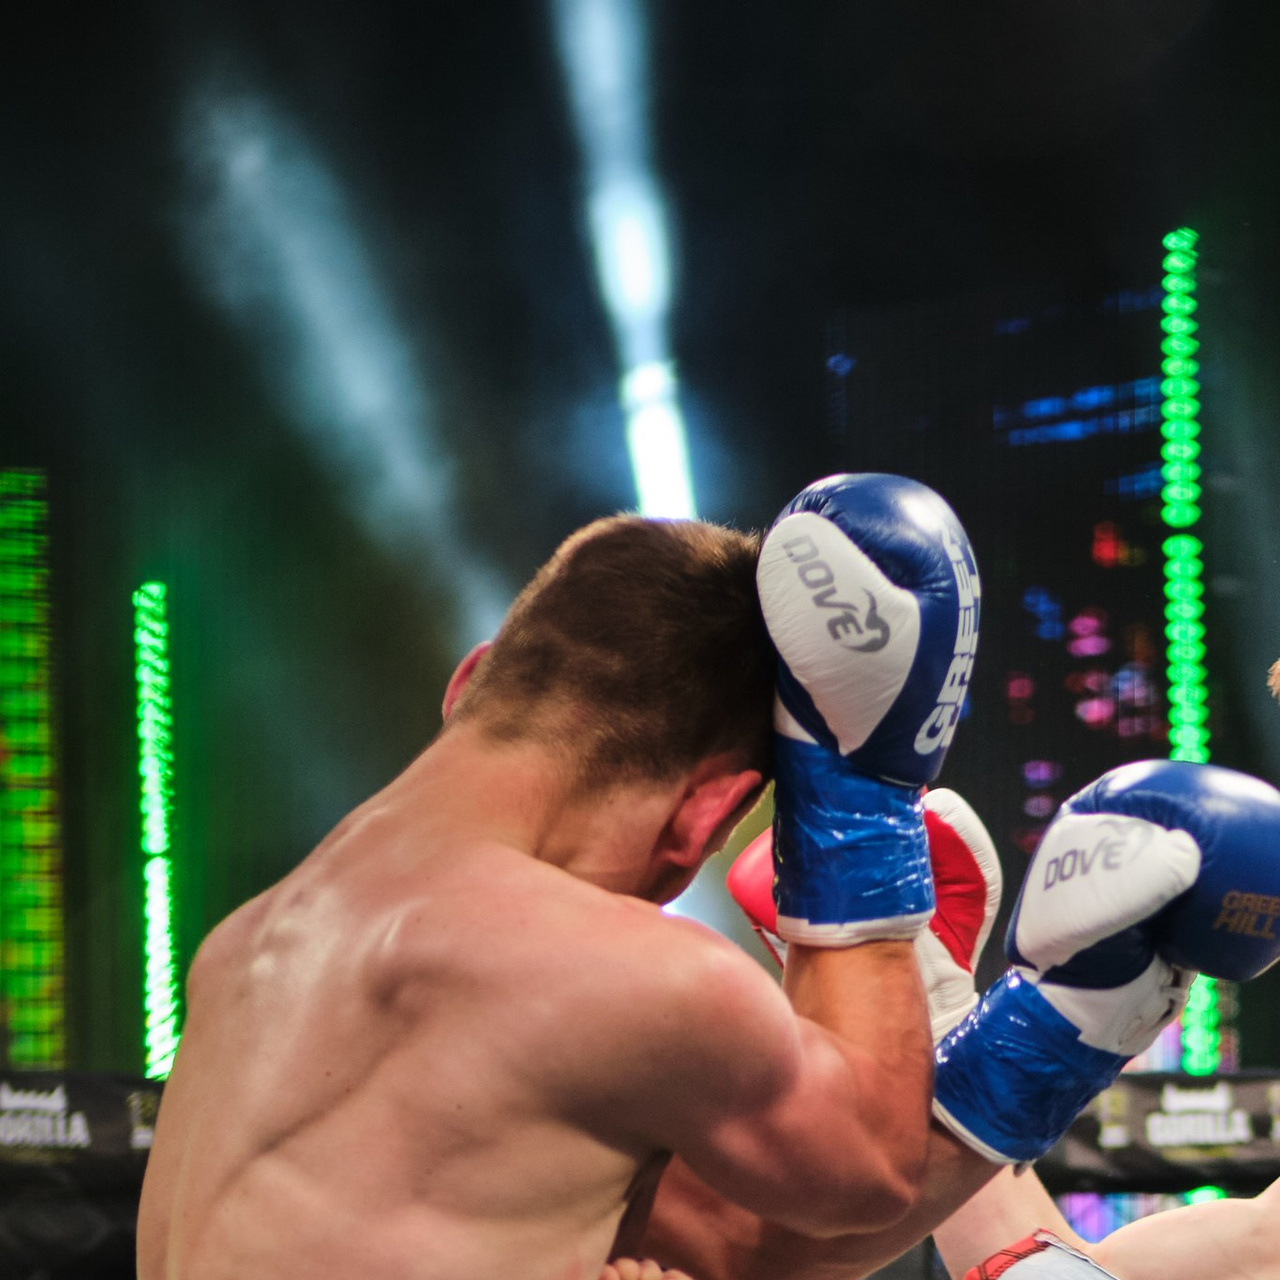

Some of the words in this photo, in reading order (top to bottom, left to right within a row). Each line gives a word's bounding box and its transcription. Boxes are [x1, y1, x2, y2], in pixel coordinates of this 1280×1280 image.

[782, 534, 864, 640] DOVE
[1044, 836, 1127, 891] DOVE
[1212, 907, 1276, 940] HILL
